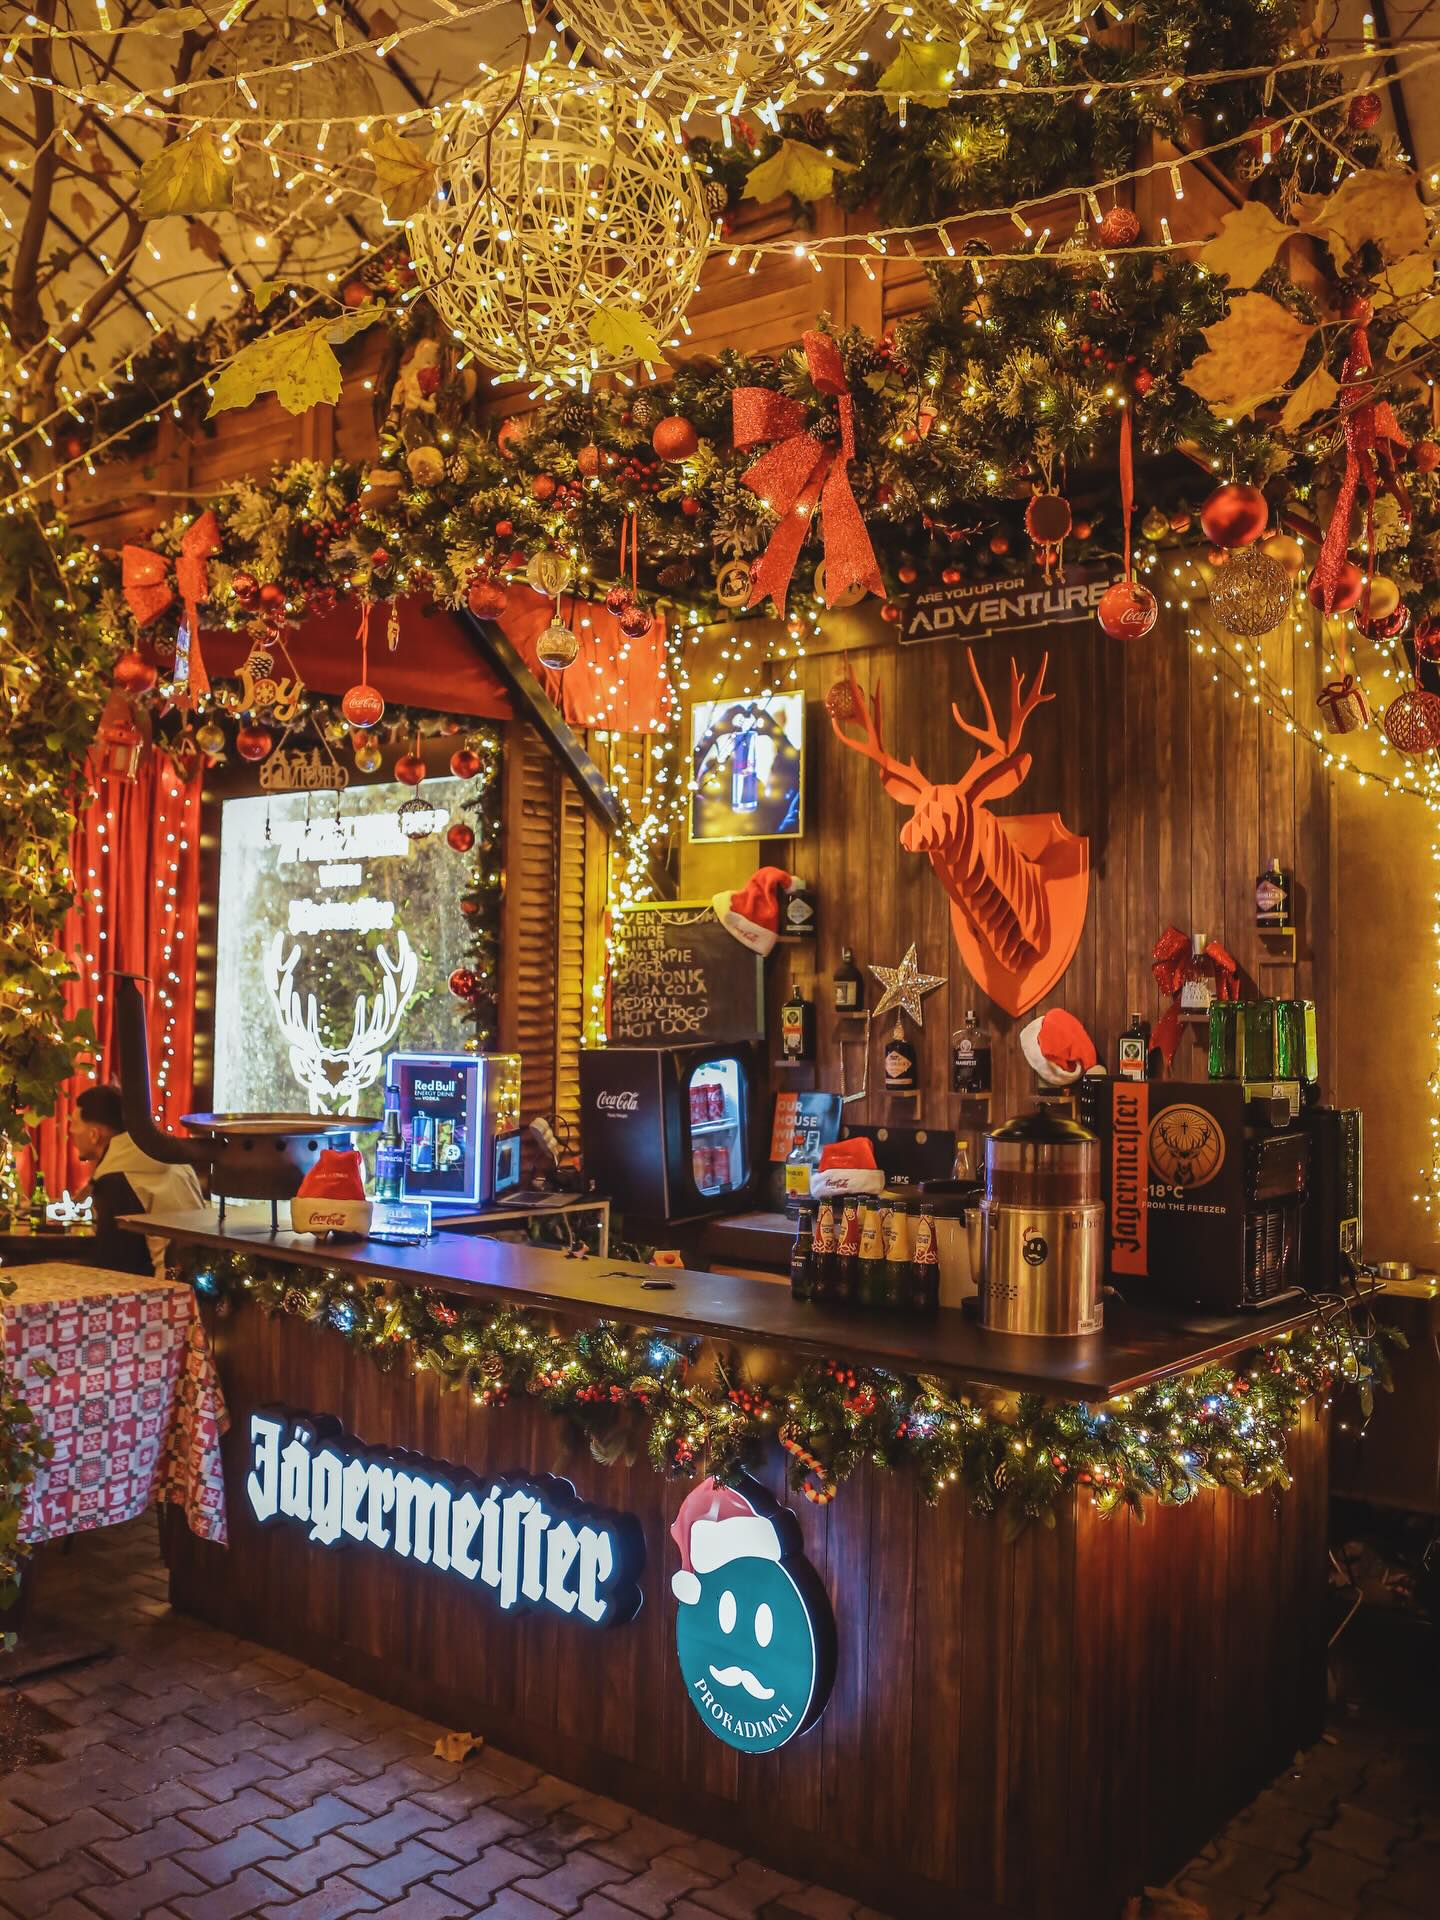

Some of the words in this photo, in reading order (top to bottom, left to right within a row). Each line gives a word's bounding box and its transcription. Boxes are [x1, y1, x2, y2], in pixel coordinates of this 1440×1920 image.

[917, 592, 943, 605] ARE
[944, 587, 974, 600] YOU
[975, 583, 994, 596] UP
[996, 578, 1025, 591] FOR
[617, 985, 660, 997] COCA
[665, 981, 707, 996] COLA
[618, 1009, 652, 1023] HOT
[618, 1022, 656, 1038] HOT
[661, 1018, 700, 1034] DOG
[414, 1080, 434, 1092] Red
[435, 1080, 455, 1092] Bull
[597, 1090, 639, 1110] Coca-Cola
[777, 1101, 803, 1112] OUR
[776, 1115, 818, 1128] HOUSE
[1142, 1201, 1166, 1211] FROM
[1168, 1203, 1185, 1212] THE
[1187, 1204, 1226, 1215] FREEZER
[309, 1212, 347, 1226] Coca-Cola
[694, 1678, 794, 1738] PROKADIMNI
